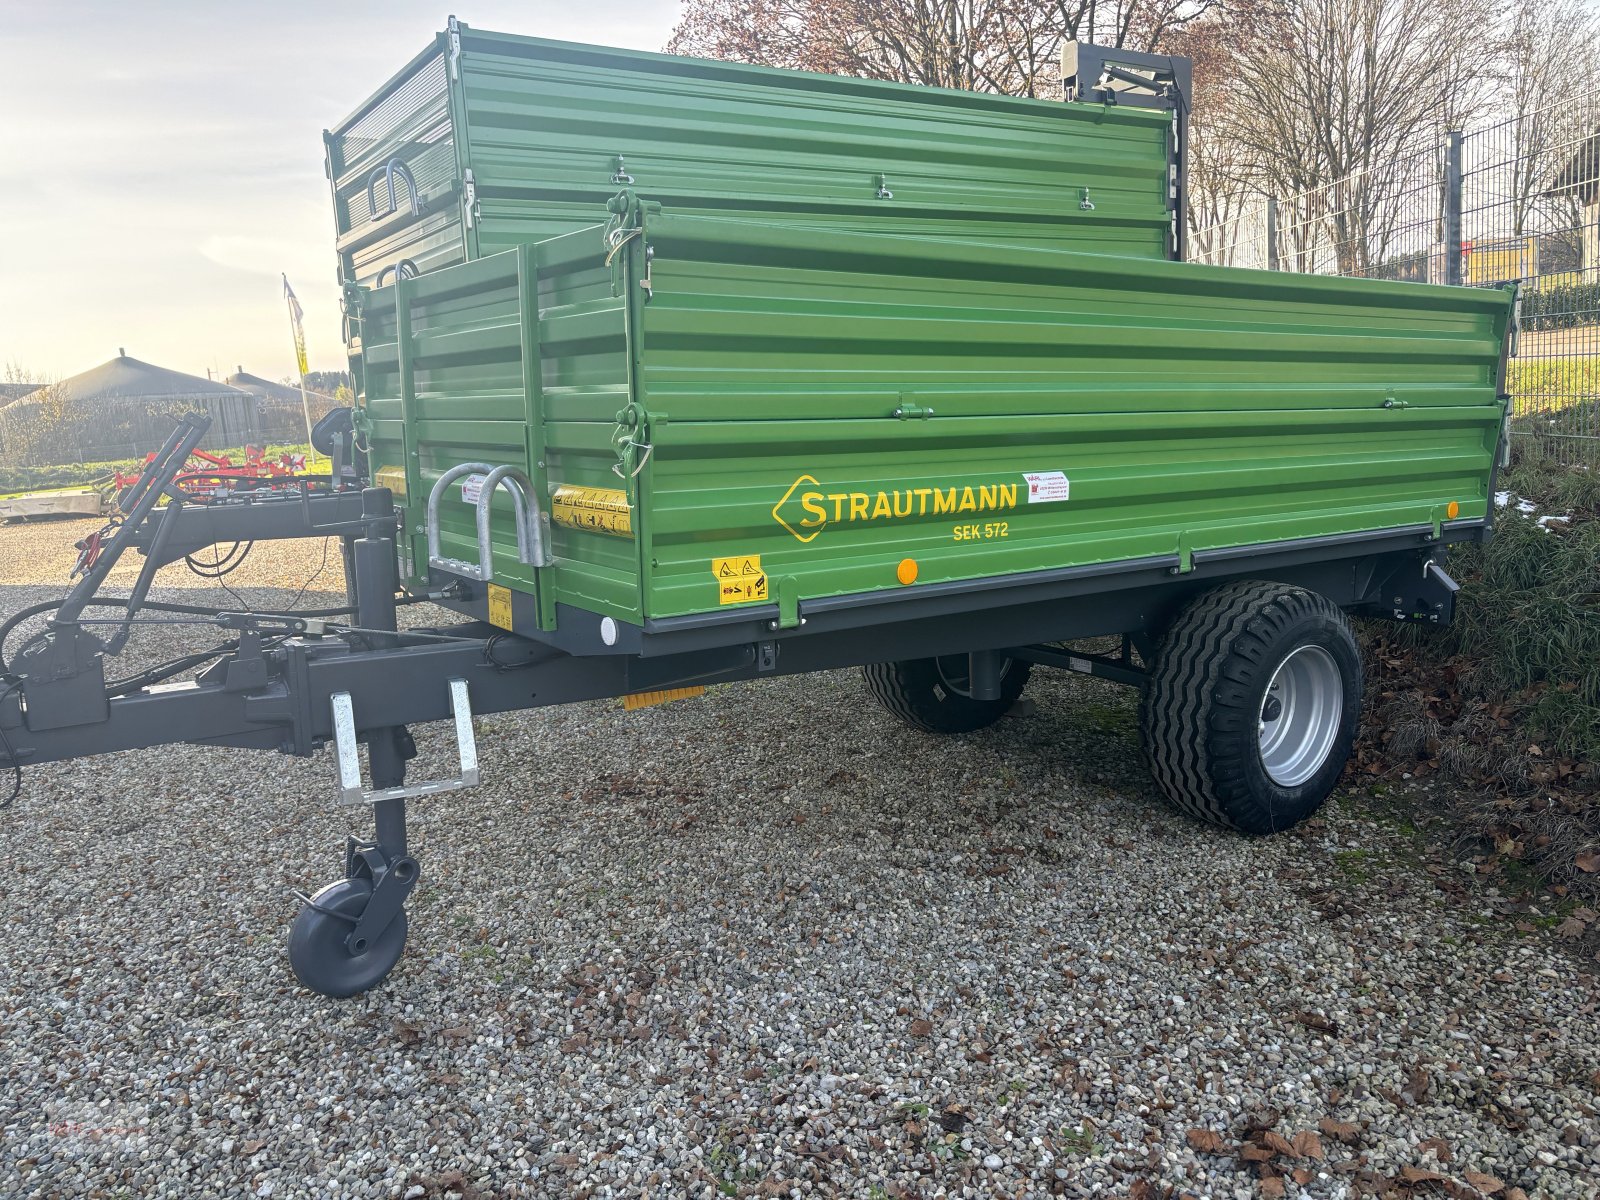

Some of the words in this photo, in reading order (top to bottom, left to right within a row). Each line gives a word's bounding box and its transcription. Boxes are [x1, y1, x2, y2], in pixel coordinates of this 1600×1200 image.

[800, 484, 1017, 527] STRAUTMANN
[953, 524, 981, 541] SEK
[985, 522, 1009, 538] 572
